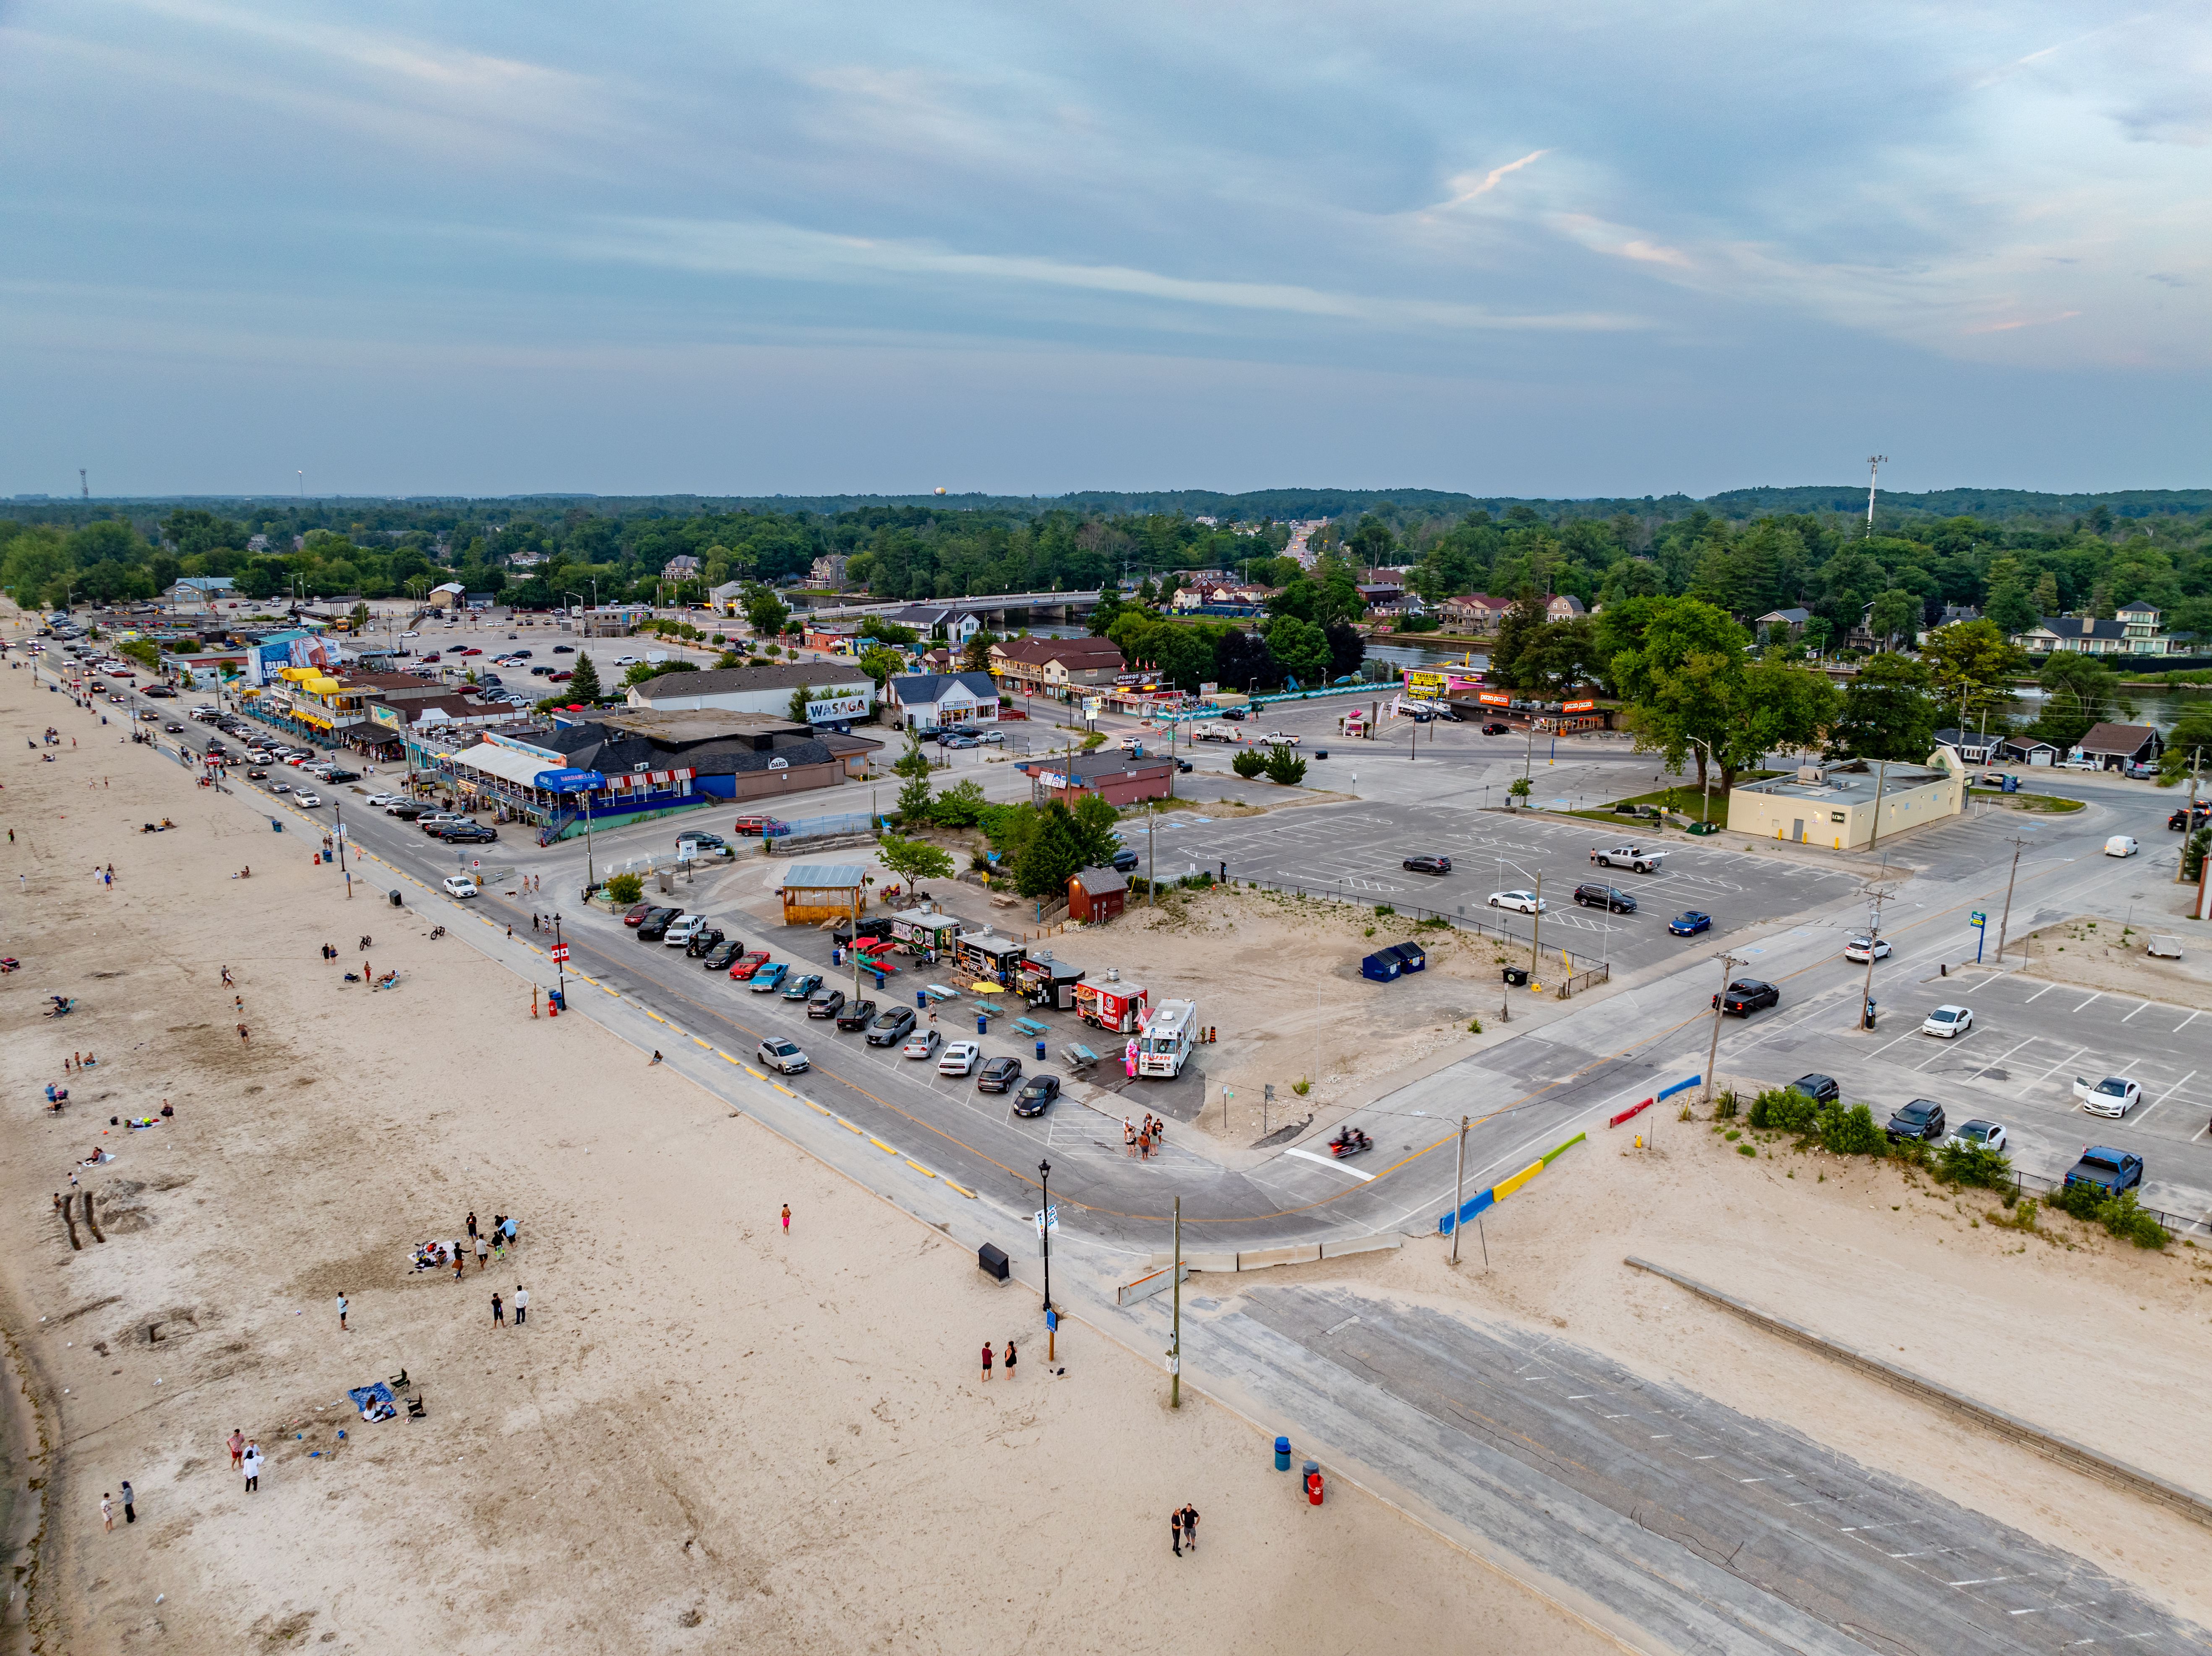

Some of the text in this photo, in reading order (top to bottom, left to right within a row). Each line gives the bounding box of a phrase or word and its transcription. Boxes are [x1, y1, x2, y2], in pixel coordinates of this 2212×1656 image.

[265, 661, 289, 670] BUD
[263, 670, 283, 678] LIG
[810, 700, 865, 717] WASAGA
[1565, 701, 1591, 711] pizza pizza
[561, 773, 595, 781] DARDANELLA
